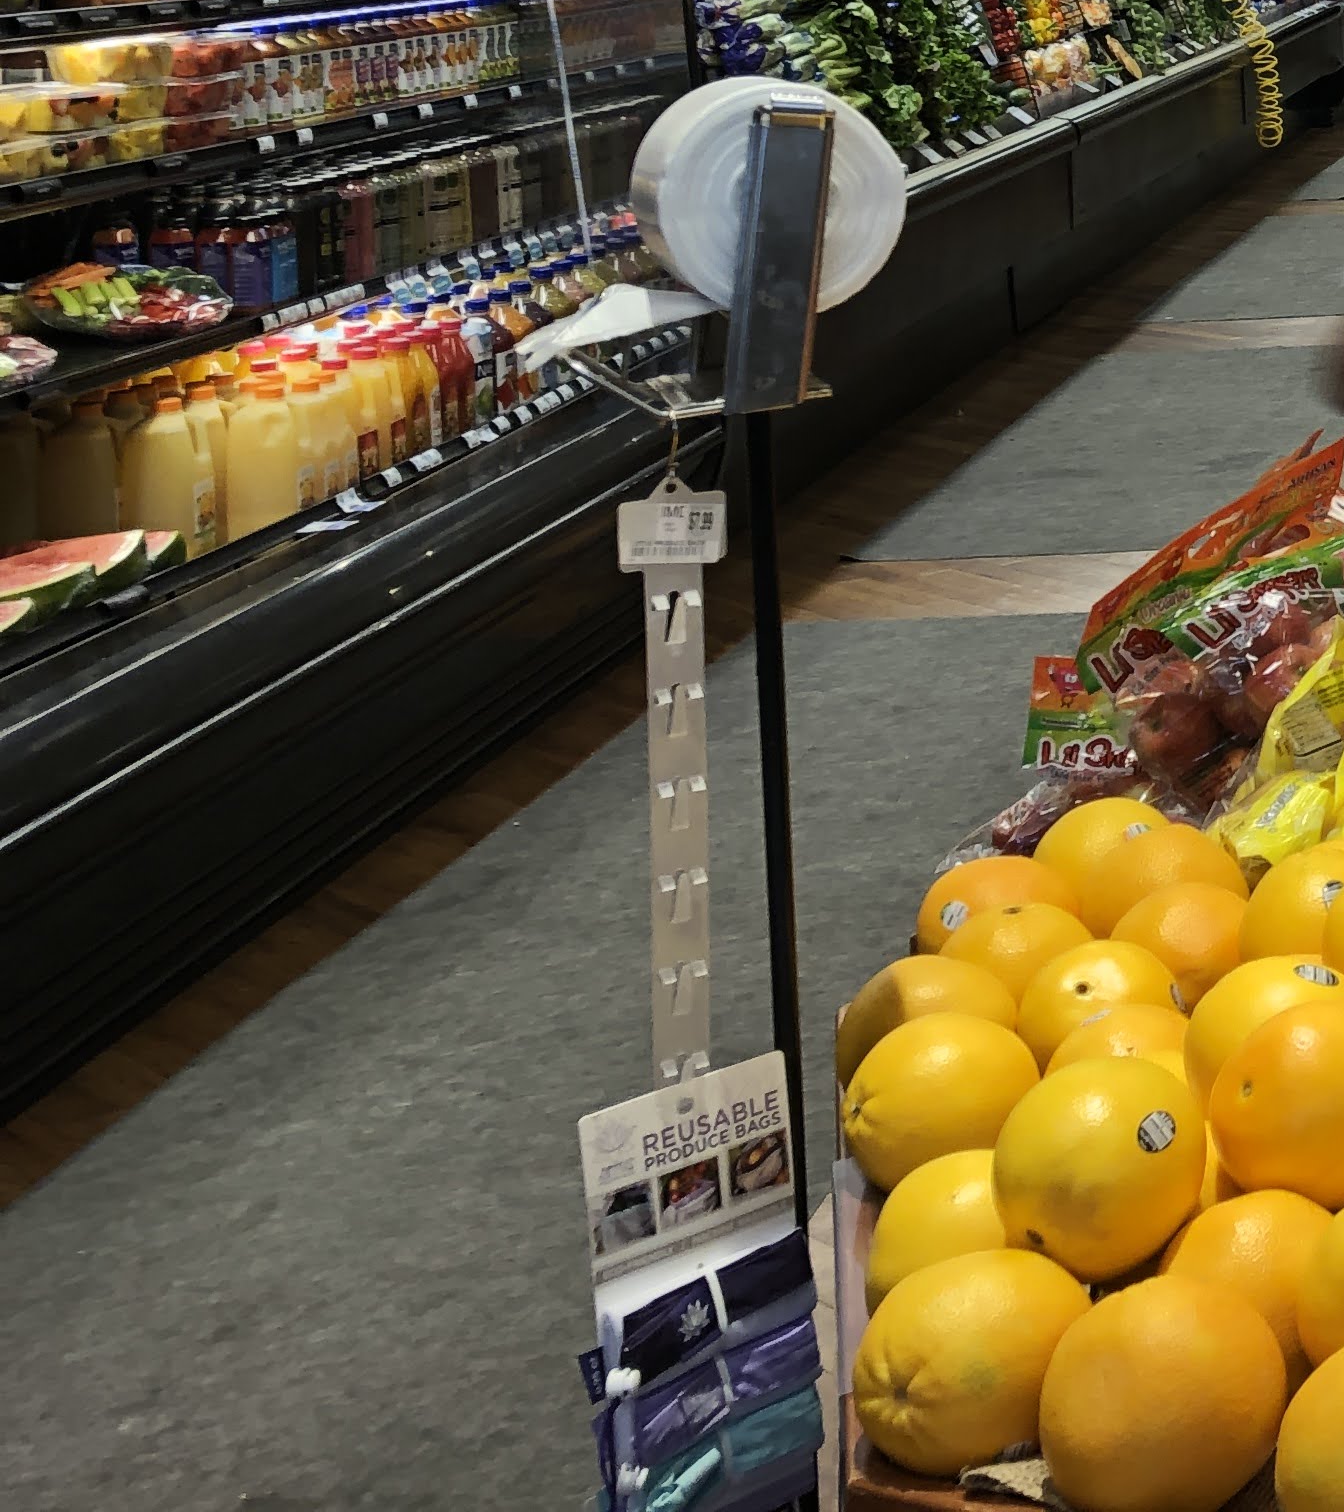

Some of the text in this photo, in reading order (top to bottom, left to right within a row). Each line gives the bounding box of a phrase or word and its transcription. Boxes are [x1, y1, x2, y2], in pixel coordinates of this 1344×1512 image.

[643, 1089, 780, 1157] REUSABLE
[644, 1110, 784, 1172] PRODUCE BAGS
